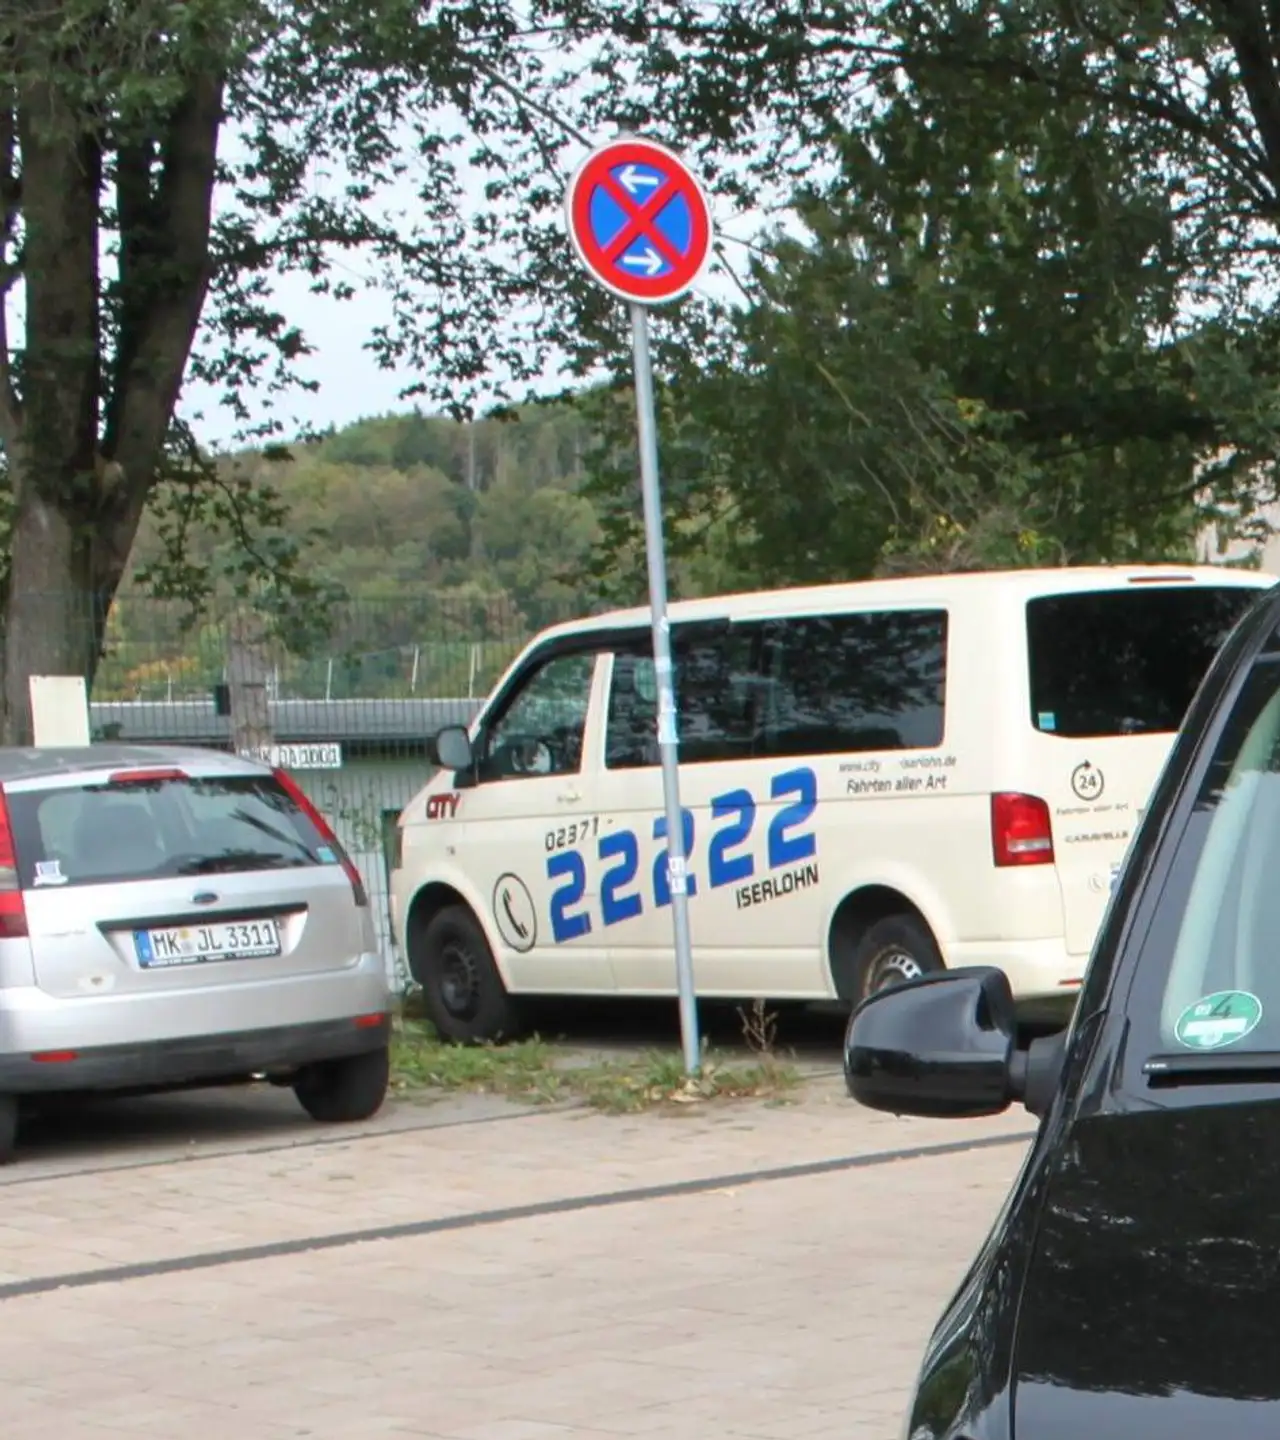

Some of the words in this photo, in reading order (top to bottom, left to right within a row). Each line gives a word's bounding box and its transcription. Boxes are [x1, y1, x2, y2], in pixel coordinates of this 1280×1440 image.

[847, 778, 892, 794] Fahrten
[895, 776, 922, 791] aller
[925, 774, 947, 789] Art
[1080, 775, 1097, 790] 24
[545, 816, 600, 852] 02371
[546, 766, 818, 944] 22222
[736, 864, 819, 909] ISERLOHN
[151, 931, 181, 957] MK
[197, 927, 223, 951] JL
[225, 923, 275, 948] 3311
